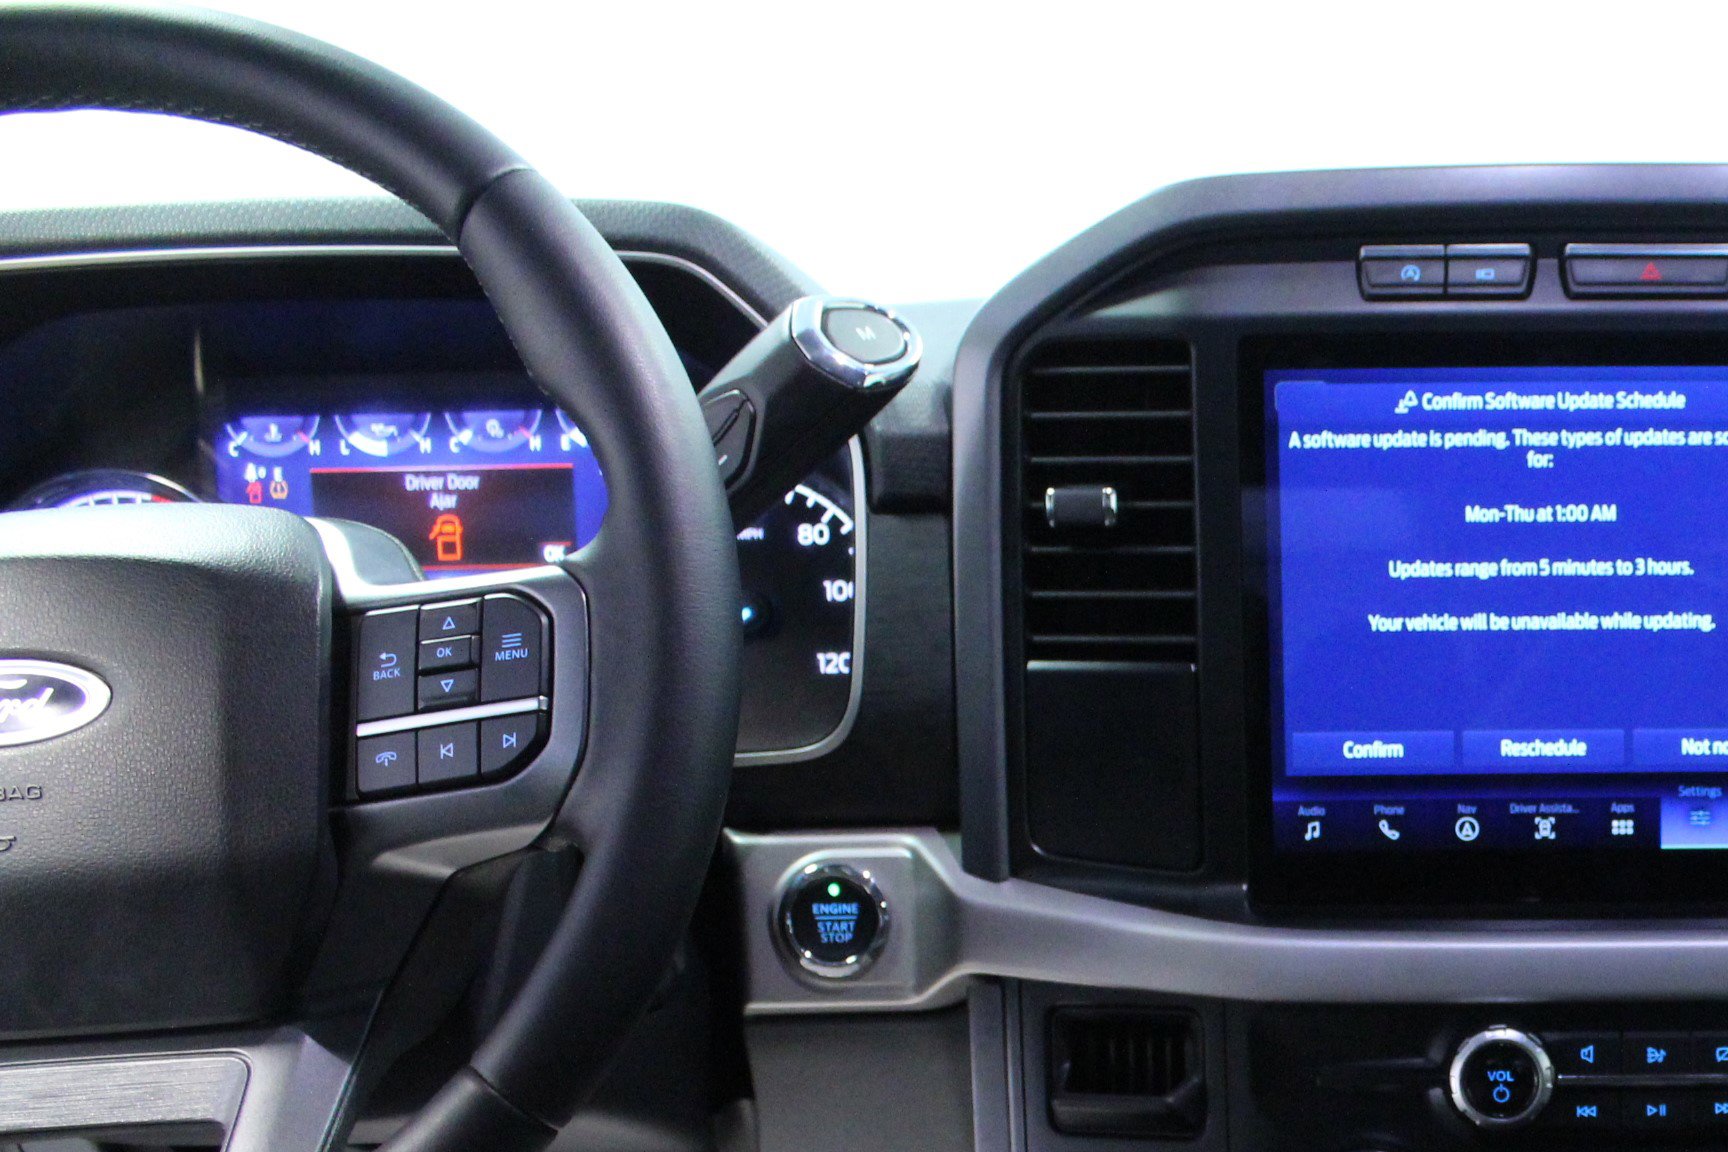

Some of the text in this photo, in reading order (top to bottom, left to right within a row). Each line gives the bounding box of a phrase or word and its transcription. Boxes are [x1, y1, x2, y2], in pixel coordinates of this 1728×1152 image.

[856, 325, 877, 342] M
[1422, 390, 1687, 412] Confirm Software Update Schedule
[1288, 431, 1302, 449] A
[1303, 430, 1372, 449] software
[1373, 429, 1428, 451] update
[1429, 429, 1443, 448] is
[1444, 428, 1510, 450] pending.
[1512, 428, 1559, 447] These
[1560, 428, 1603, 449] types
[1604, 427, 1622, 447] of
[1624, 427, 1686, 449] updates
[1687, 431, 1713, 446] are
[1526, 449, 1554, 468] for:
[405, 472, 480, 491] Driver Door
[429, 494, 458, 511] Ajar
[1465, 503, 1617, 523] Mon-Thu at 1:00 AM
[797, 523, 830, 546] 80
[1388, 557, 1694, 580] Updates range from 5 minutes to 3 hours.
[1368, 611, 1716, 632] Your vehicle will be unavailable while updating.
[436, 647, 452, 658] OK
[495, 648, 528, 661] MENU
[373, 667, 401, 681] BACK
[1343, 740, 1404, 758] Confirm
[1500, 738, 1587, 757] Reschedule
[1681, 738, 1711, 755] Not
[1678, 785, 1722, 798] Settings
[1298, 804, 1327, 816] Audio
[1373, 804, 1406, 816] Phone
[1456, 803, 1478, 815] Nav
[1509, 803, 1537, 814] Driver
[1610, 802, 1635, 815] Apps
[811, 902, 859, 915] ENGINE
[817, 921, 856, 932] START
[820, 932, 854, 944] STOP
[1487, 1070, 1514, 1083] VOL
